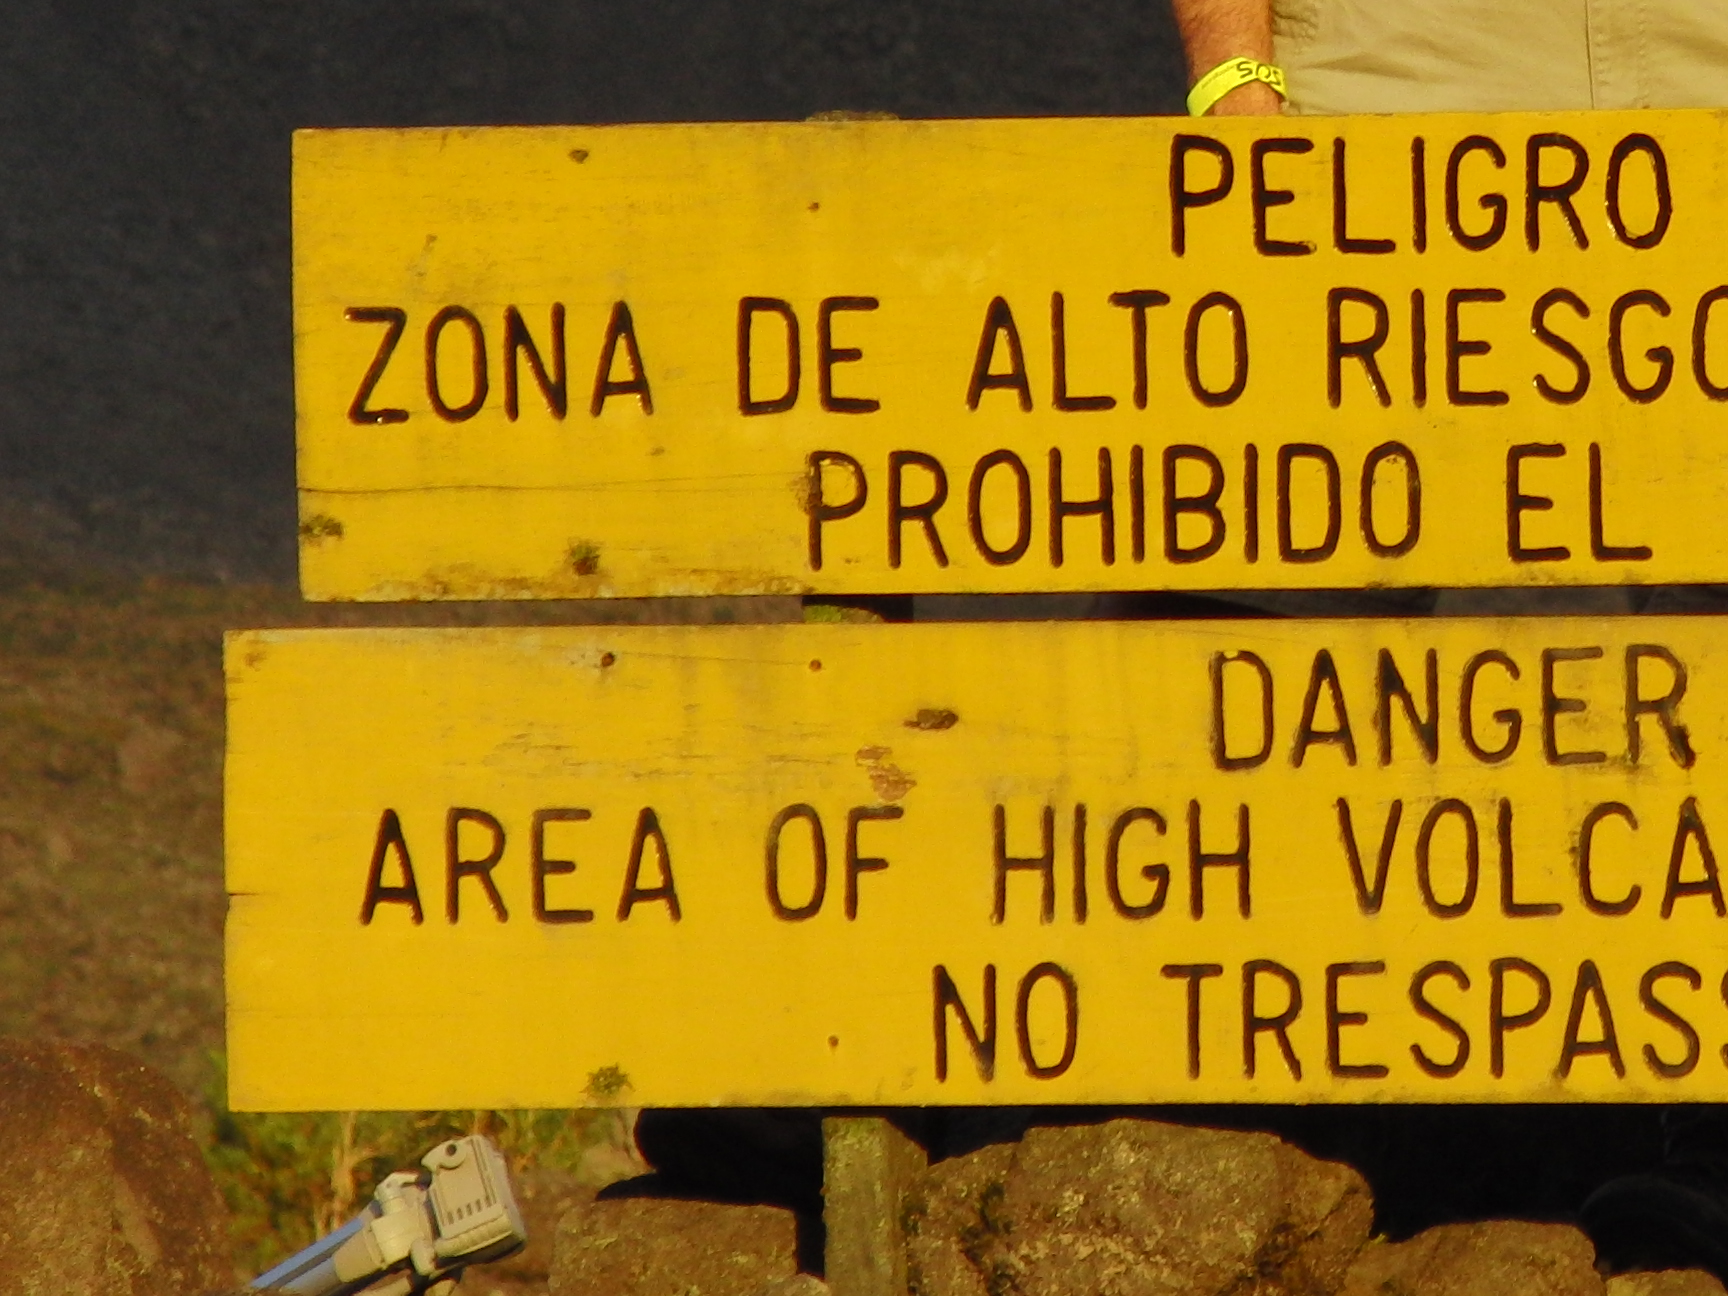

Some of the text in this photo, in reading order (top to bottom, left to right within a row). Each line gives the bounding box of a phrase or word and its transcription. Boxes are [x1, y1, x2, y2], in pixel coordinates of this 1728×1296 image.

[1168, 132, 1674, 258] PELIGRO
[346, 299, 654, 425] ZONA
[737, 295, 881, 416] DE
[966, 289, 1250, 412] ALTO
[806, 440, 1423, 571] PROHIBIDO
[1505, 441, 1654, 563] EL
[1211, 643, 1697, 772] DANGER
[361, 806, 682, 925] AREA
[766, 803, 905, 921] OF
[993, 799, 1252, 923] HIGH
[933, 961, 1079, 1081] NO
